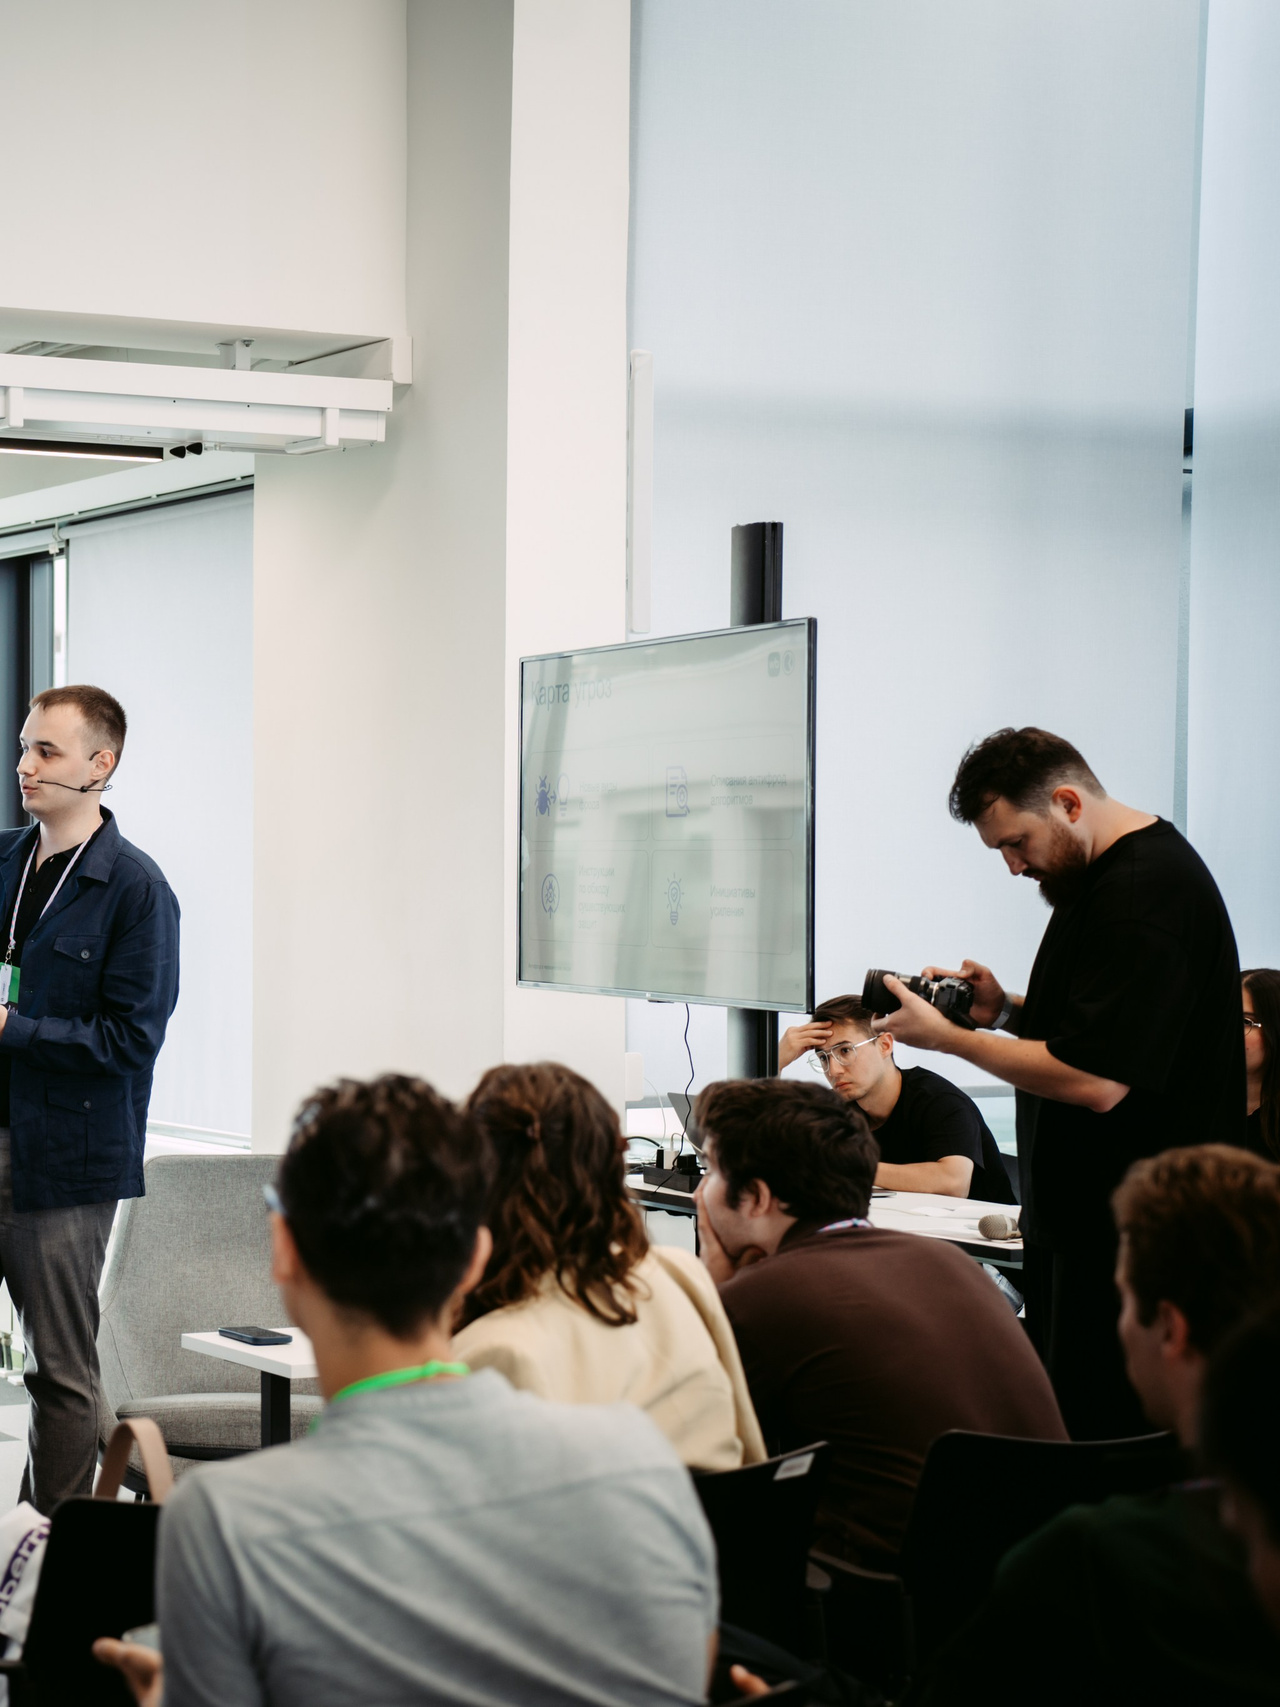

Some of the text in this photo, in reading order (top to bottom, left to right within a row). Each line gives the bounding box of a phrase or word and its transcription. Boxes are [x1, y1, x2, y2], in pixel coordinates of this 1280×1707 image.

[531, 679, 612, 711] Карта угроз
[710, 772, 787, 788] Описания антифрод
[710, 794, 753, 808] алгоритмов
[710, 885, 756, 899] Инициативы
[709, 906, 744, 919] усиления
